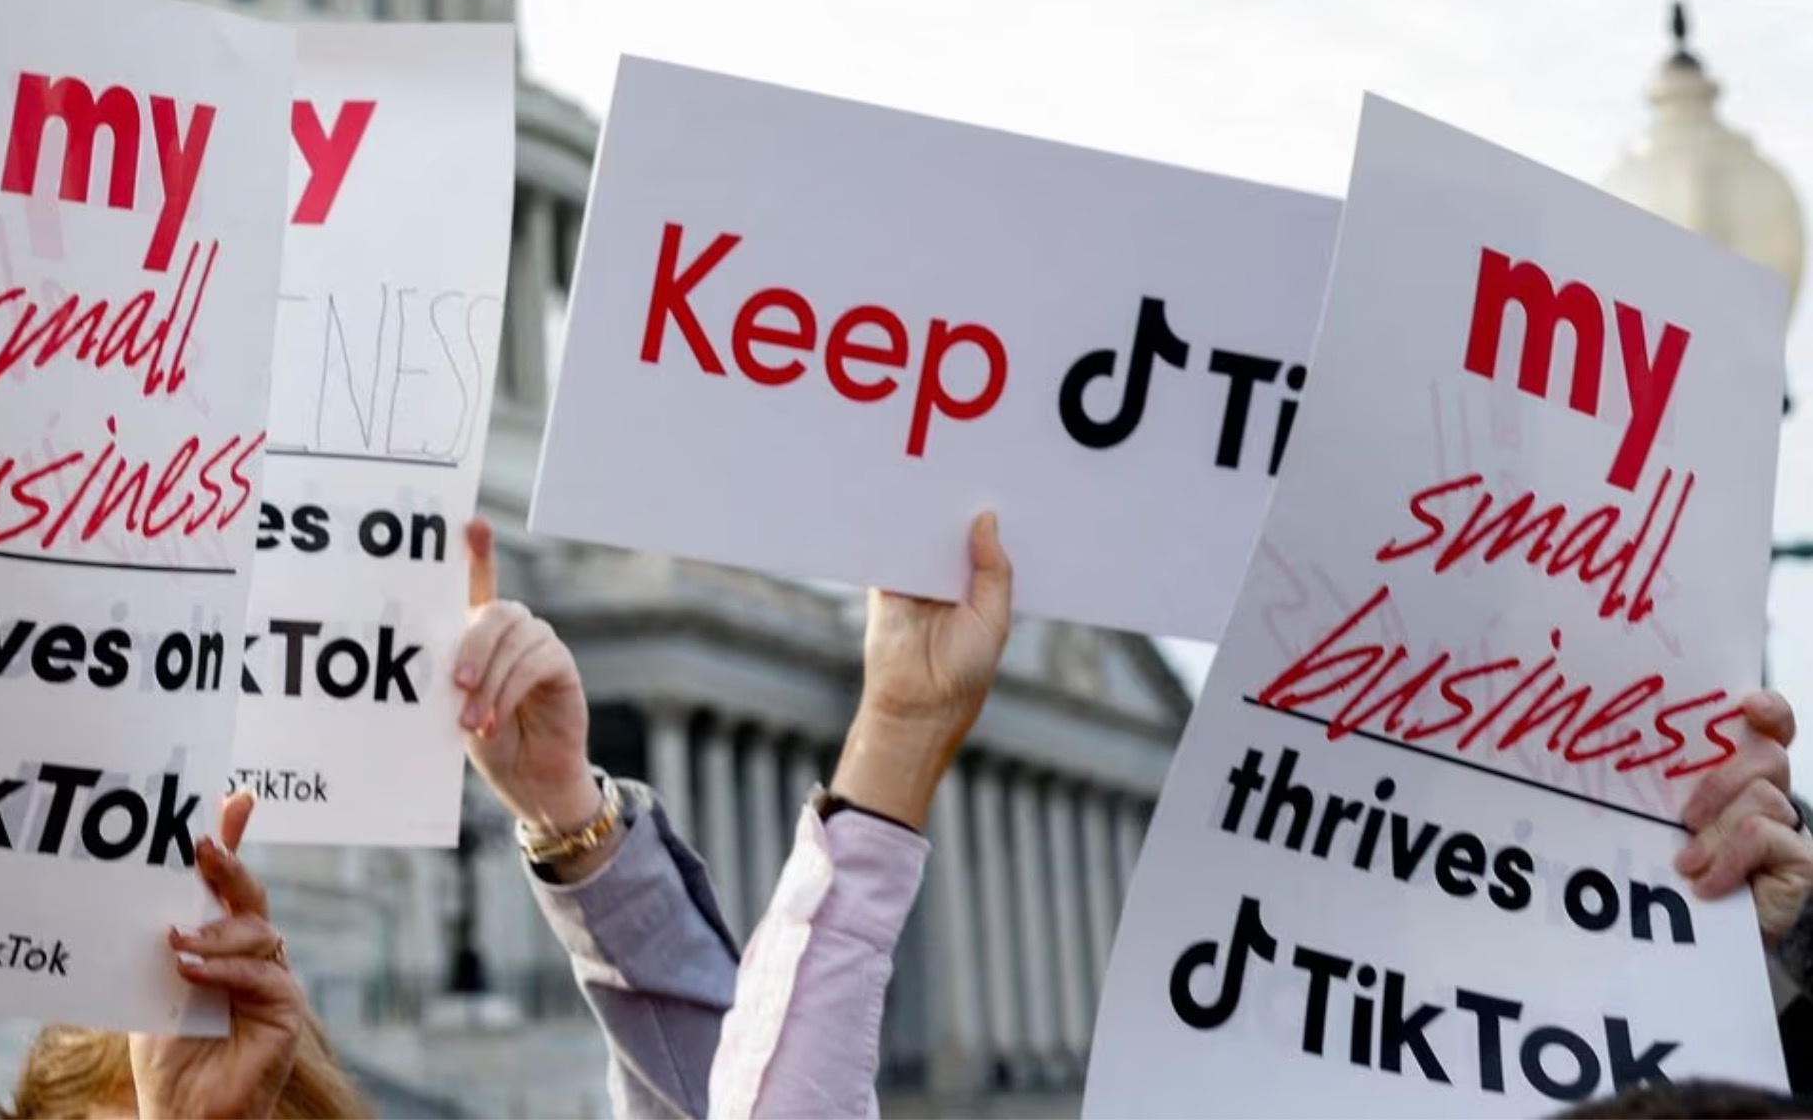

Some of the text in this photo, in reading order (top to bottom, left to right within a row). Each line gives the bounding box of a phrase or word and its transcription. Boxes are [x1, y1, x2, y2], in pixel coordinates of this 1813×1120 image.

[0, 71, 216, 273] my
[639, 221, 1009, 457] Keep
[1464, 246, 1691, 492] my
[357, 509, 448, 562] on
[1376, 468, 1695, 622] small
[154, 631, 225, 691] on
[1259, 585, 1745, 778] business
[1220, 747, 1696, 944] thrives on
[1292, 945, 1684, 1104] TikTok
